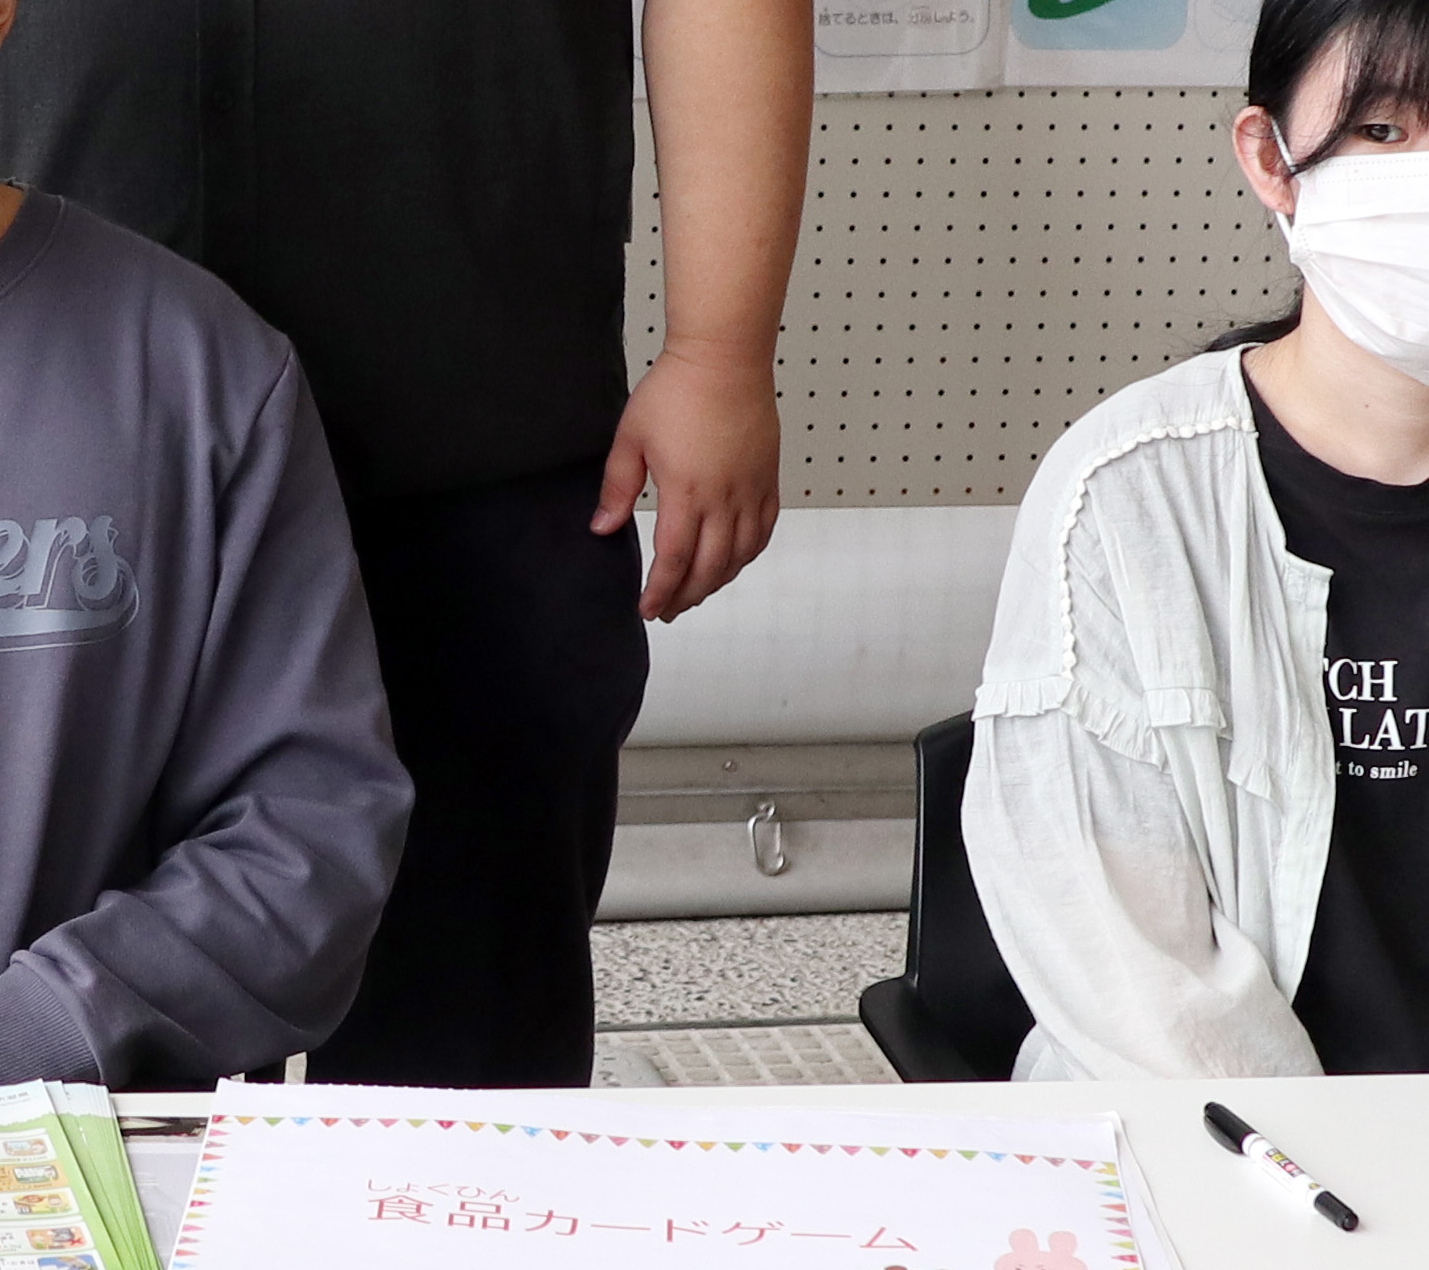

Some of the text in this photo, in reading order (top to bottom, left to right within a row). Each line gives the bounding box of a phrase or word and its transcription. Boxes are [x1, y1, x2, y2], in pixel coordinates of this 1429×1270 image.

[1323, 658, 1398, 702] CH
[1348, 761, 1364, 777] to
[1369, 760, 1418, 779] smile
[366, 1176, 520, 1203] しょくひん
[366, 1191, 919, 1253] 食品カードゲーム
